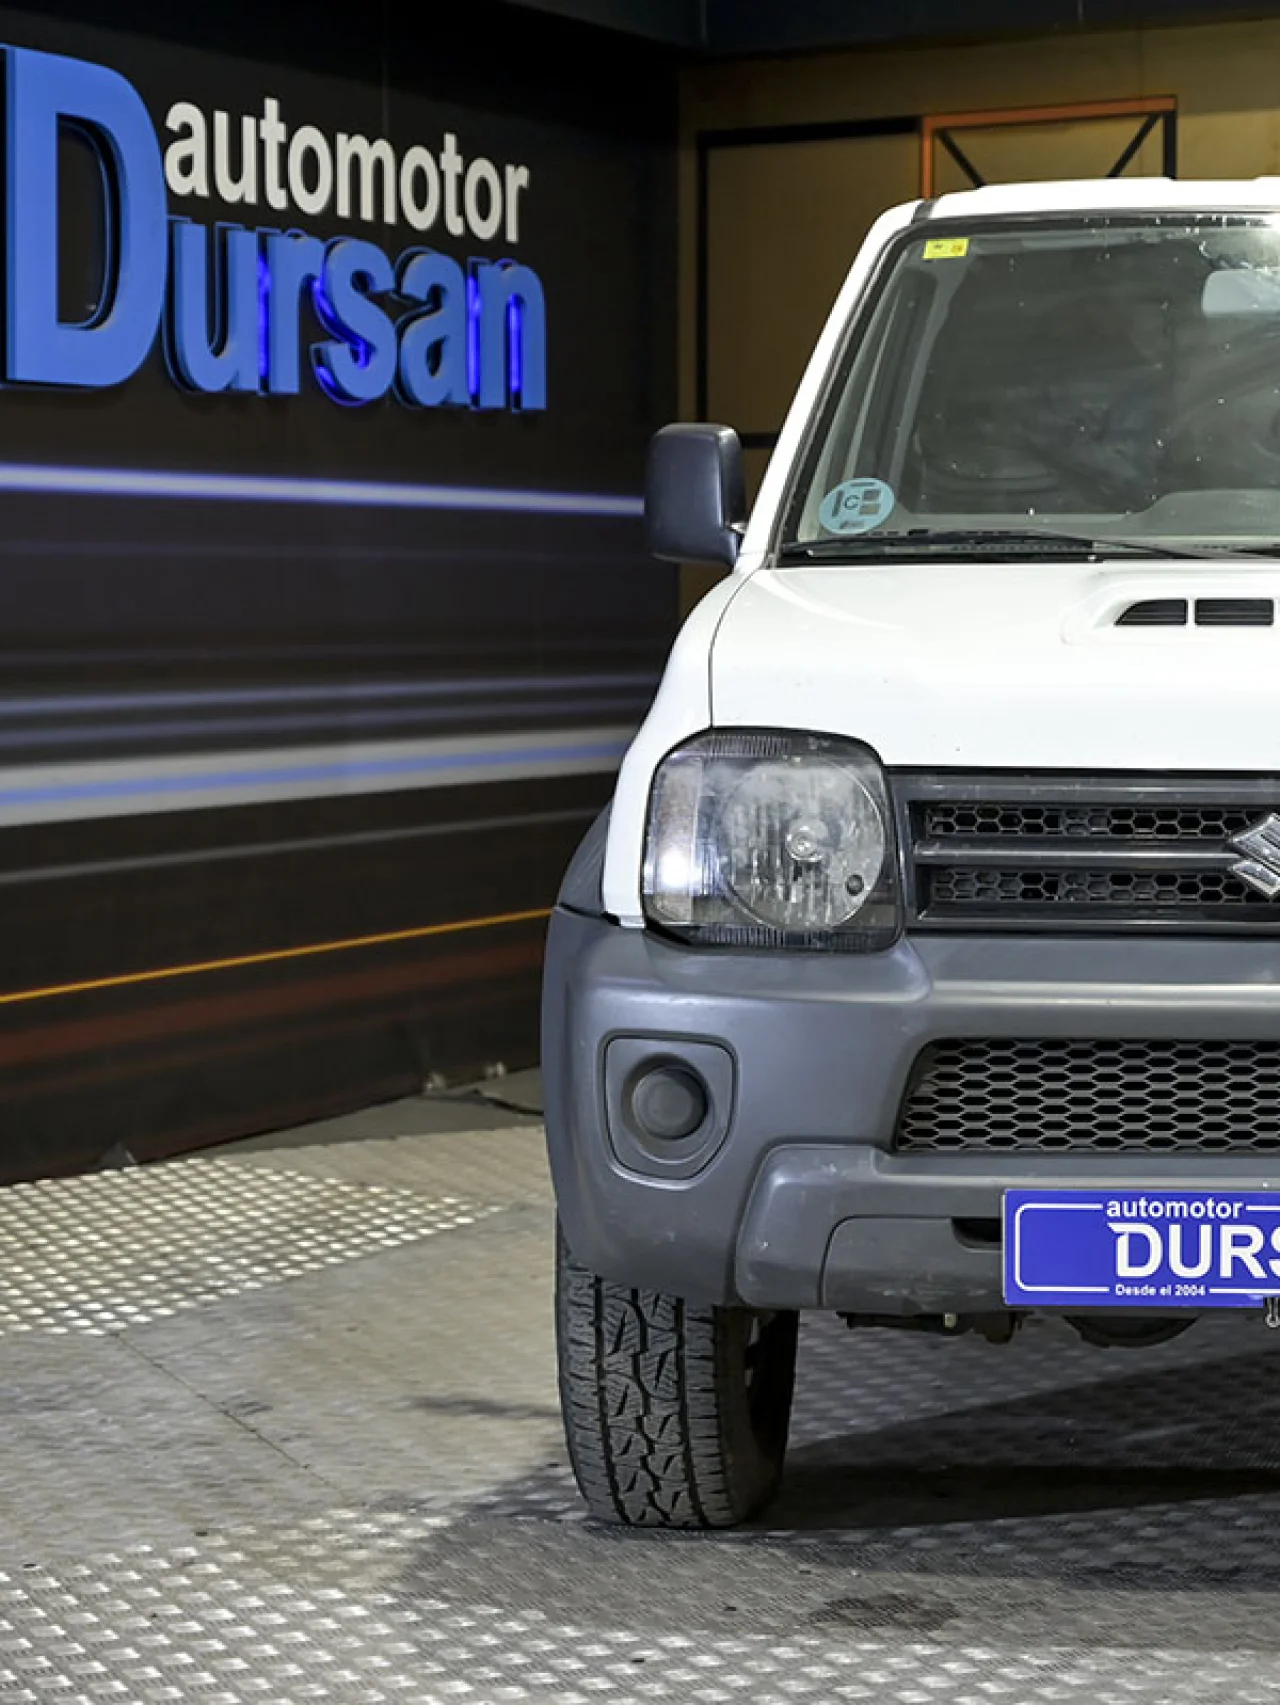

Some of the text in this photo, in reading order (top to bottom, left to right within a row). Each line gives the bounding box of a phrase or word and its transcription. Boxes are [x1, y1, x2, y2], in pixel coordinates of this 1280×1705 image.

[165, 98, 530, 242] automotor
[0, 42, 547, 412] Dursan
[1106, 1197, 1243, 1219] automotor
[1115, 1284, 1157, 1296] Desde
